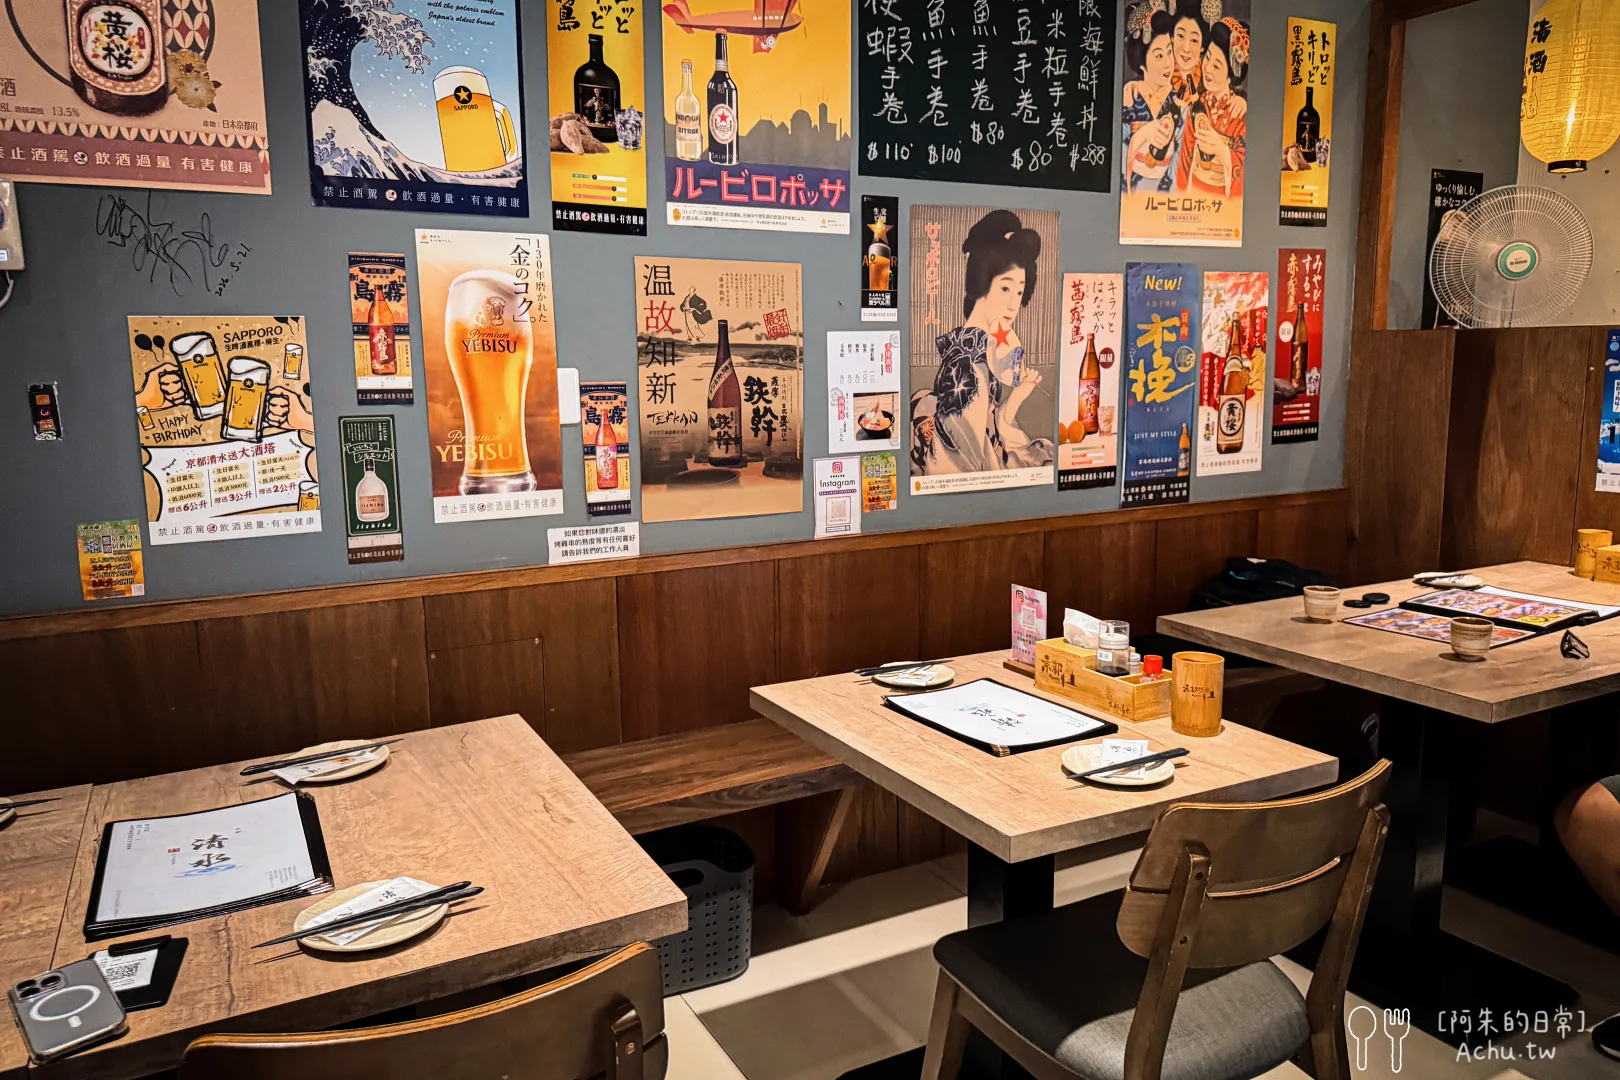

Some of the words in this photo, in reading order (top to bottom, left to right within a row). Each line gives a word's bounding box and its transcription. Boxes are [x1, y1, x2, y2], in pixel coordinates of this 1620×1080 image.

[443, 2, 454, 10] the
[455, 4, 479, 13] polaris
[480, 8, 505, 16] emblem
[428, 11, 455, 21] Japan's
[455, 15, 475, 24] oldest
[476, 18, 496, 26] brand
[1320, 32, 1330, 85] トロッと
[52, 106, 80, 117] 13.5%
[0, 146, 68, 163] 止酒駕
[95, 151, 172, 169] 飲酒過量
[180, 157, 254, 174] 有害健康
[1070, 145, 1106, 171] $288
[323, 186, 378, 200] 禁止酒駕
[535, 239, 548, 323] 130年磨かれた
[925, 222, 941, 326] サッポロビール
[1144, 275, 1182, 291] New!
[1312, 254, 1322, 312] みやびに
[1093, 281, 1104, 333] はなやか
[1107, 280, 1117, 333] キラッと
[223, 325, 283, 343] SAPPORO
[469, 328, 509, 340] Premium
[643, 264, 677, 404] 温故知新
[461, 338, 518, 354] YEBISU
[158, 414, 189, 430] HAPPY
[647, 410, 698, 428] TEKKAN
[153, 424, 203, 444] BIRTHDAY
[445, 429, 501, 444] Premium
[1134, 431, 1148, 440] JUST
[185, 442, 276, 469] 京都清水送大酒塔
[435, 442, 513, 463] YEBISU
[820, 478, 856, 489] Instagram
[1602, 478, 1620, 487] 禁止
[441, 503, 476, 515] 禁止酒駕
[157, 525, 205, 537] 禁止酒駕
[561, 545, 629, 557] 請告訴我們的工作人員
